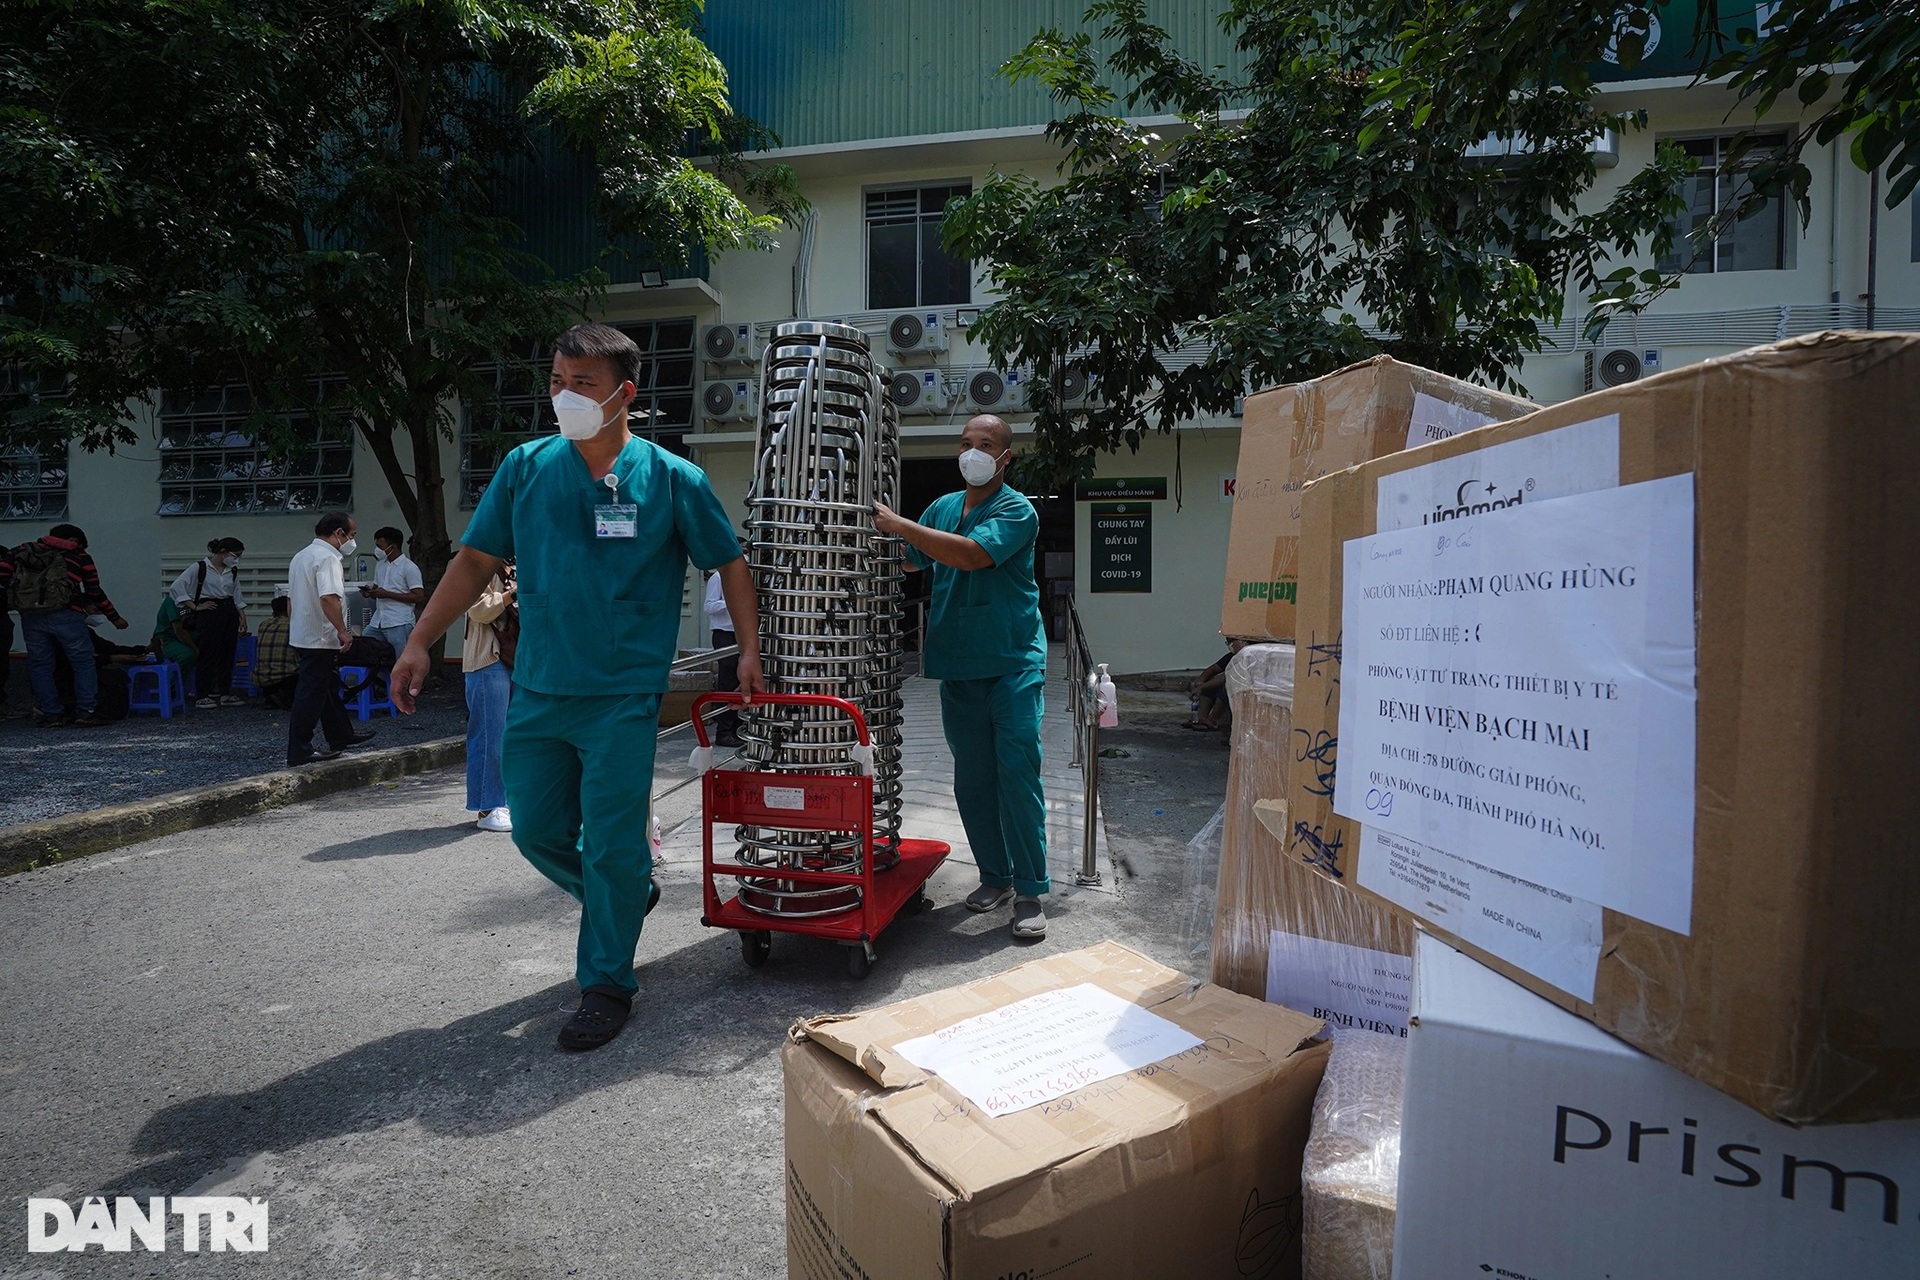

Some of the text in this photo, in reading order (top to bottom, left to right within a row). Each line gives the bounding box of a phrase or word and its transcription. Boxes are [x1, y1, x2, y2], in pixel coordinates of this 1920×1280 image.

[1097, 520, 1145, 529] CHUNG TAY
[1101, 570, 1142, 579] COVID-19
[1111, 554, 1132, 564] DỊCH
[1490, 570, 1553, 597] QUANG
[1560, 562, 1636, 590] HÙNG
[1396, 627, 1412, 642] ĐT
[1414, 623, 1440, 642] LIÊN
[1442, 624, 1460, 646] HỆ
[1368, 661, 1619, 701] PHÒNG VẬT TƯ TRANG THIẾT BỊ Y TẾ
[1379, 697, 1590, 752] BỆNH VIỆN BẠCH MAI
[1381, 742, 1399, 760] ĐỊA
[1441, 755, 1487, 779] ĐƯỜNG
[1489, 766, 1520, 788] GIẢI
[1525, 775, 1586, 804] PHÓNG,
[1370, 770, 1398, 789] QUẬN
[1457, 794, 1501, 820] THÀNH
[1541, 817, 1565, 839] HÀ
[1482, 906, 1543, 941] MADE IN CHINA
[1553, 1104, 1920, 1226] prism
